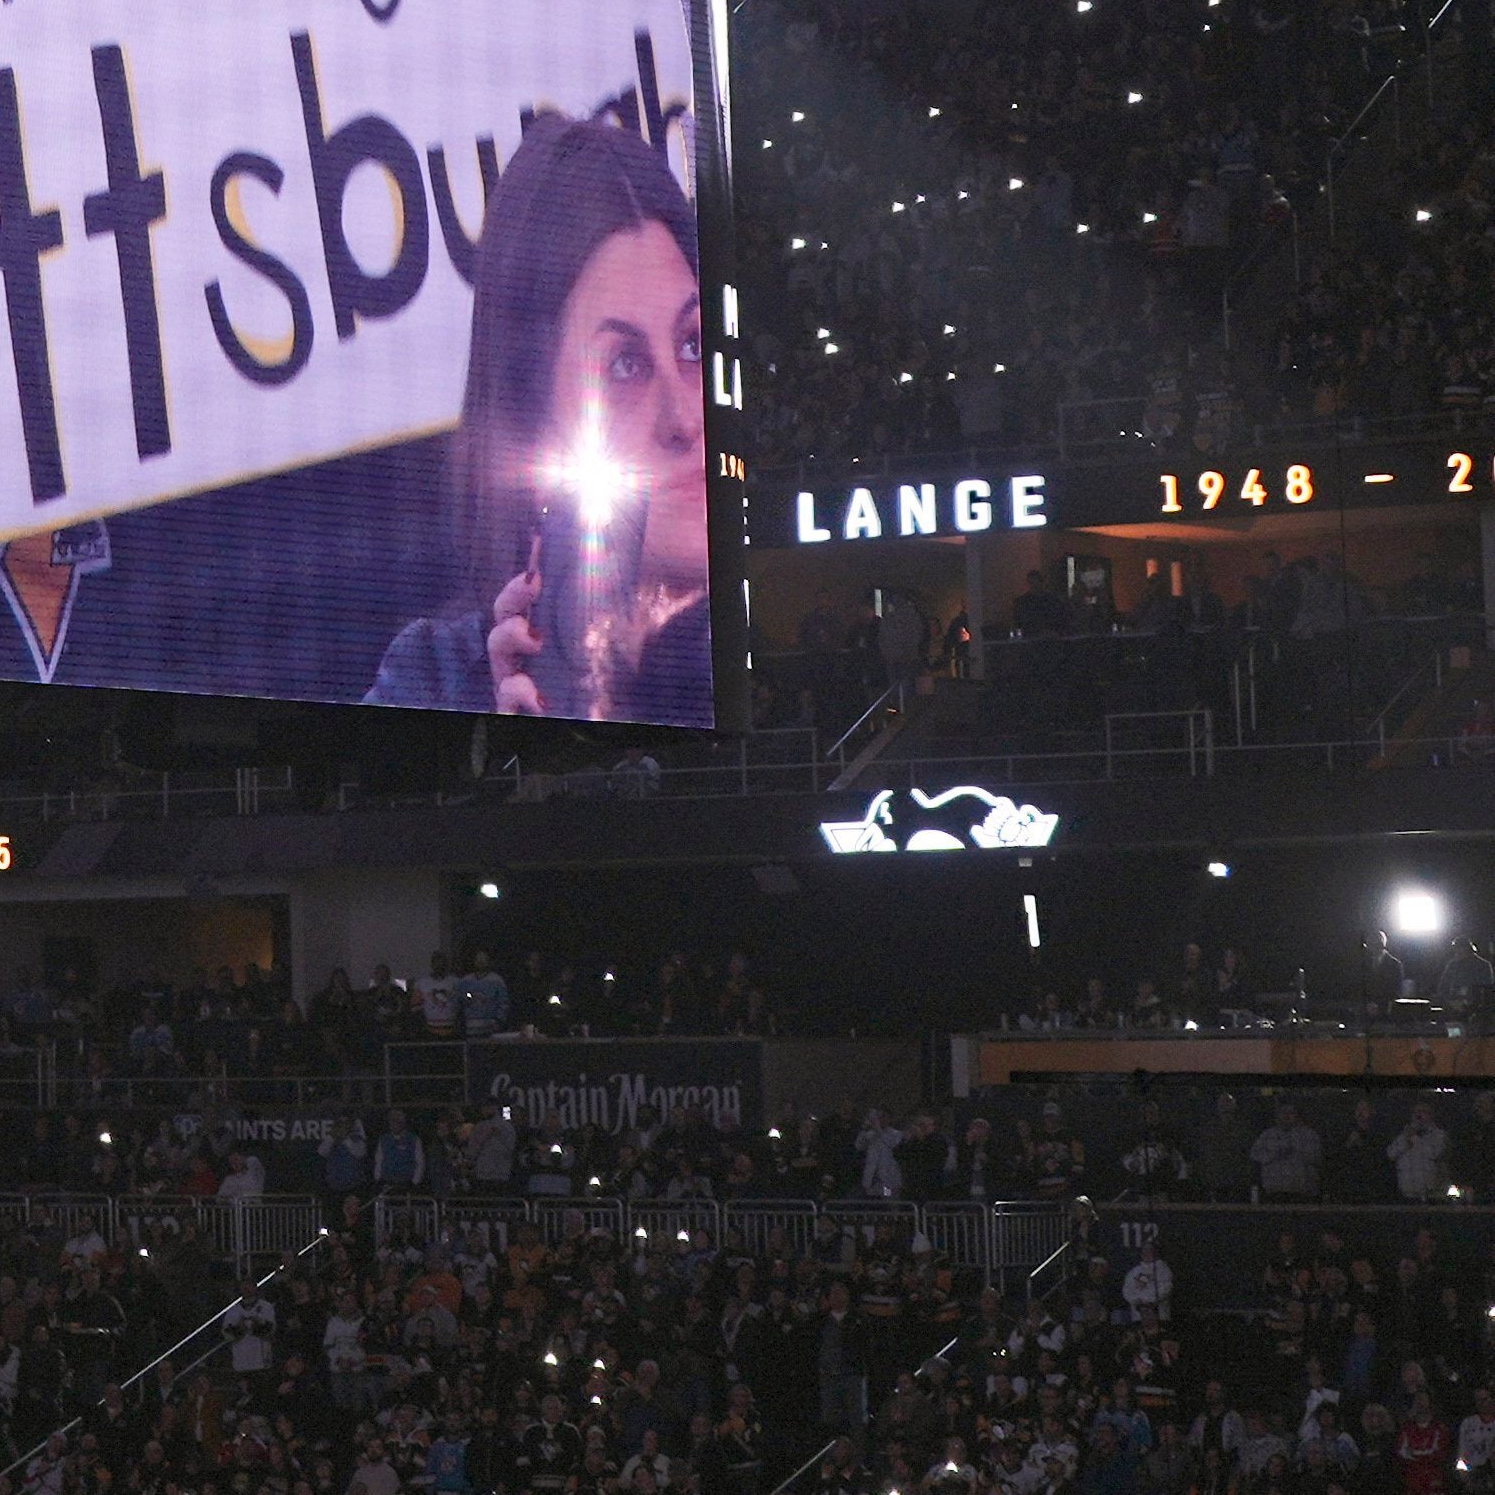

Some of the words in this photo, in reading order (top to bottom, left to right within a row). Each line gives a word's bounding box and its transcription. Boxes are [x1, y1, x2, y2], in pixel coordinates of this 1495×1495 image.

[796, 473, 1049, 544] LANGE
[1159, 463, 1316, 514] 1948
[490, 1072, 610, 1130] Captain
